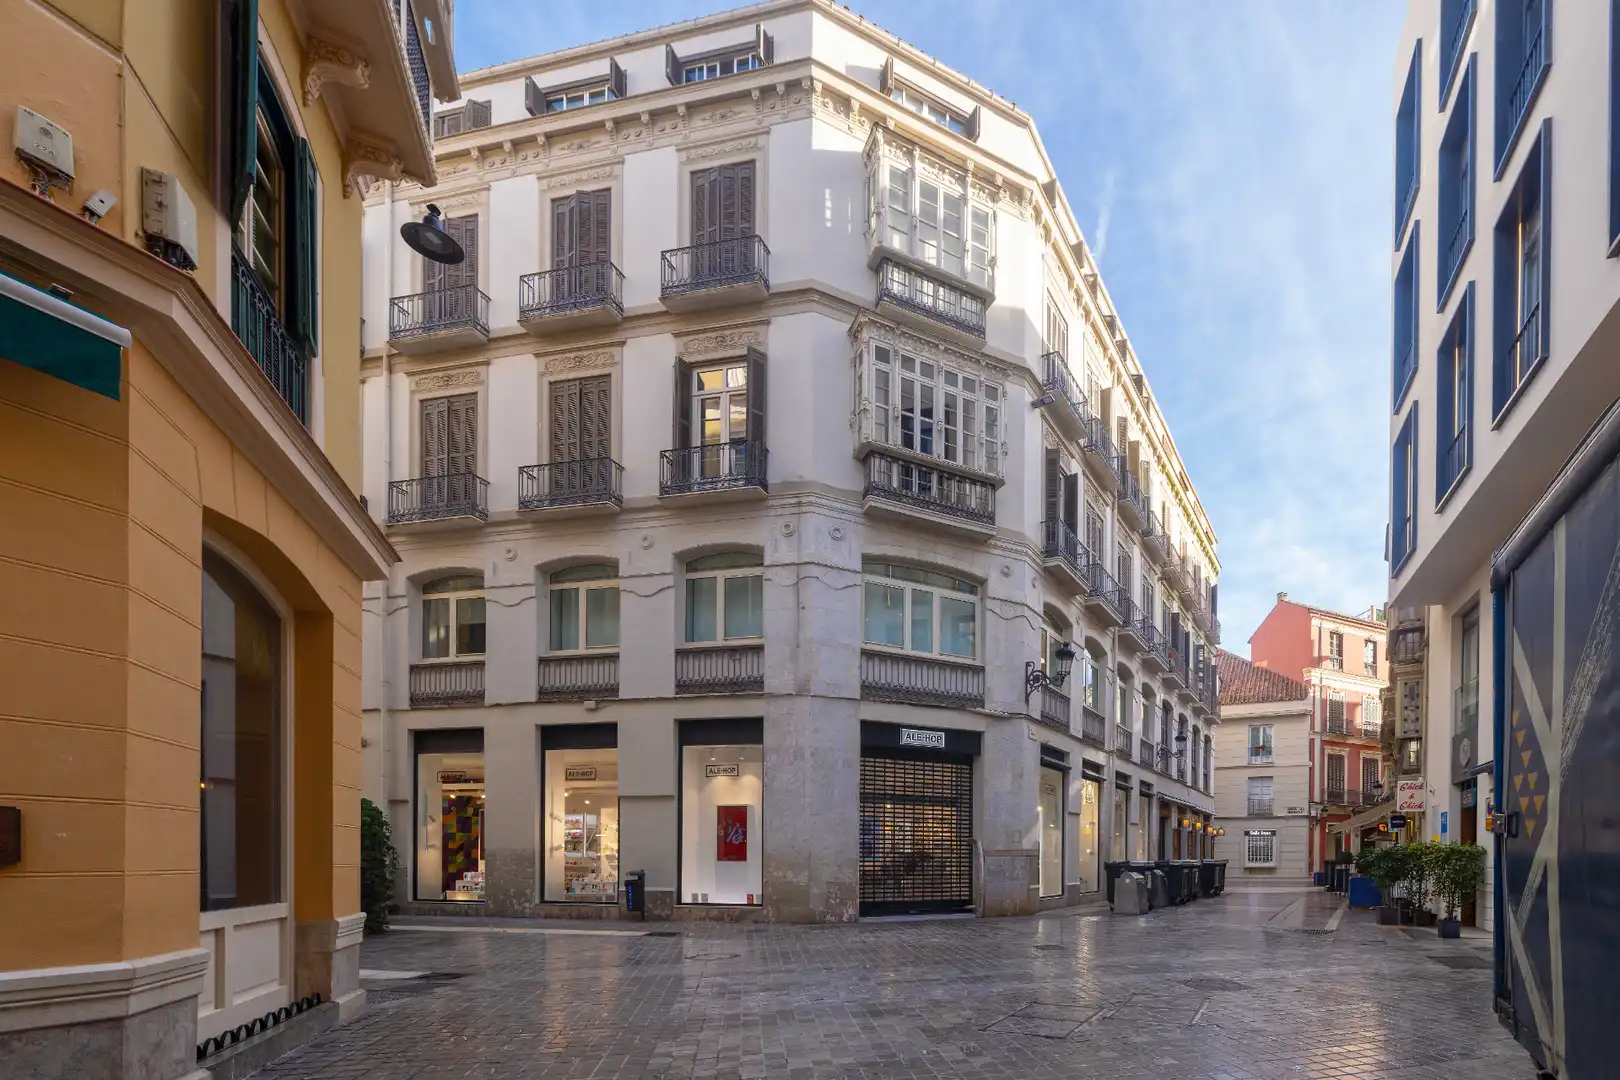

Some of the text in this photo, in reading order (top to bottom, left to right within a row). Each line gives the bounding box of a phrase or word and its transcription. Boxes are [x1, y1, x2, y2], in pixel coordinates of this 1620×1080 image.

[905, 732, 941, 743] ALE-HOP
[708, 767, 736, 775] ALE-HOP
[1400, 782, 1424, 791] Chick
[1400, 801, 1424, 810] Chick
